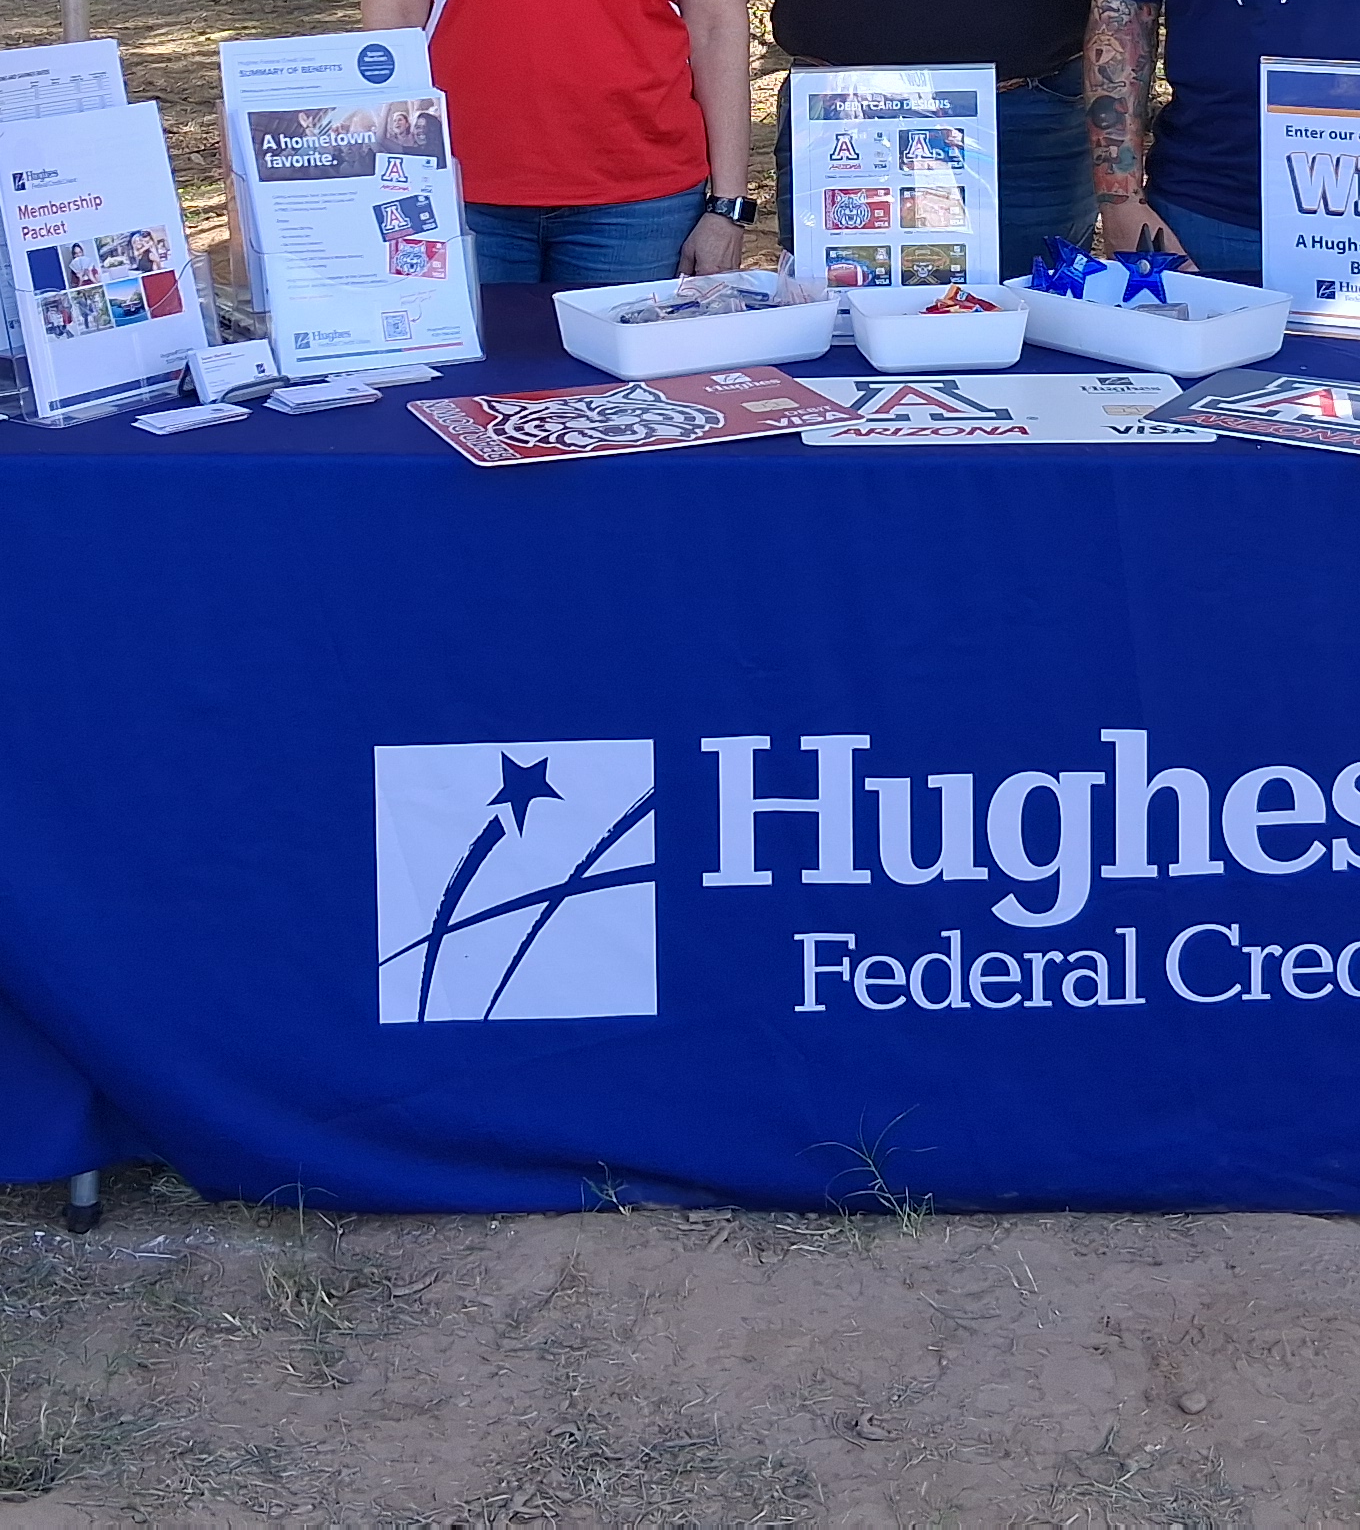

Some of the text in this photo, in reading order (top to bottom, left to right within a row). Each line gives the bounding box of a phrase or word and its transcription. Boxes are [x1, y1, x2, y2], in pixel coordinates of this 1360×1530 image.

[263, 131, 375, 150] A hometown
[1285, 125, 1325, 140] Enter
[1329, 131, 1354, 141] our
[830, 134, 859, 161] A
[905, 132, 933, 159] A
[264, 152, 338, 168] favorite.
[382, 157, 408, 183] A
[18, 193, 103, 220] Membership
[382, 202, 411, 233] A
[21, 221, 67, 241] Packet
[1296, 234, 1307, 248] A
[703, 378, 781, 393] Hughes
[784, 405, 832, 416] DEBIT
[849, 380, 1013, 422] A
[757, 411, 852, 427] VISA
[828, 425, 1030, 438] ARIZONA
[1101, 425, 1198, 435] VISA
[792, 927, 1146, 1015] Federal
